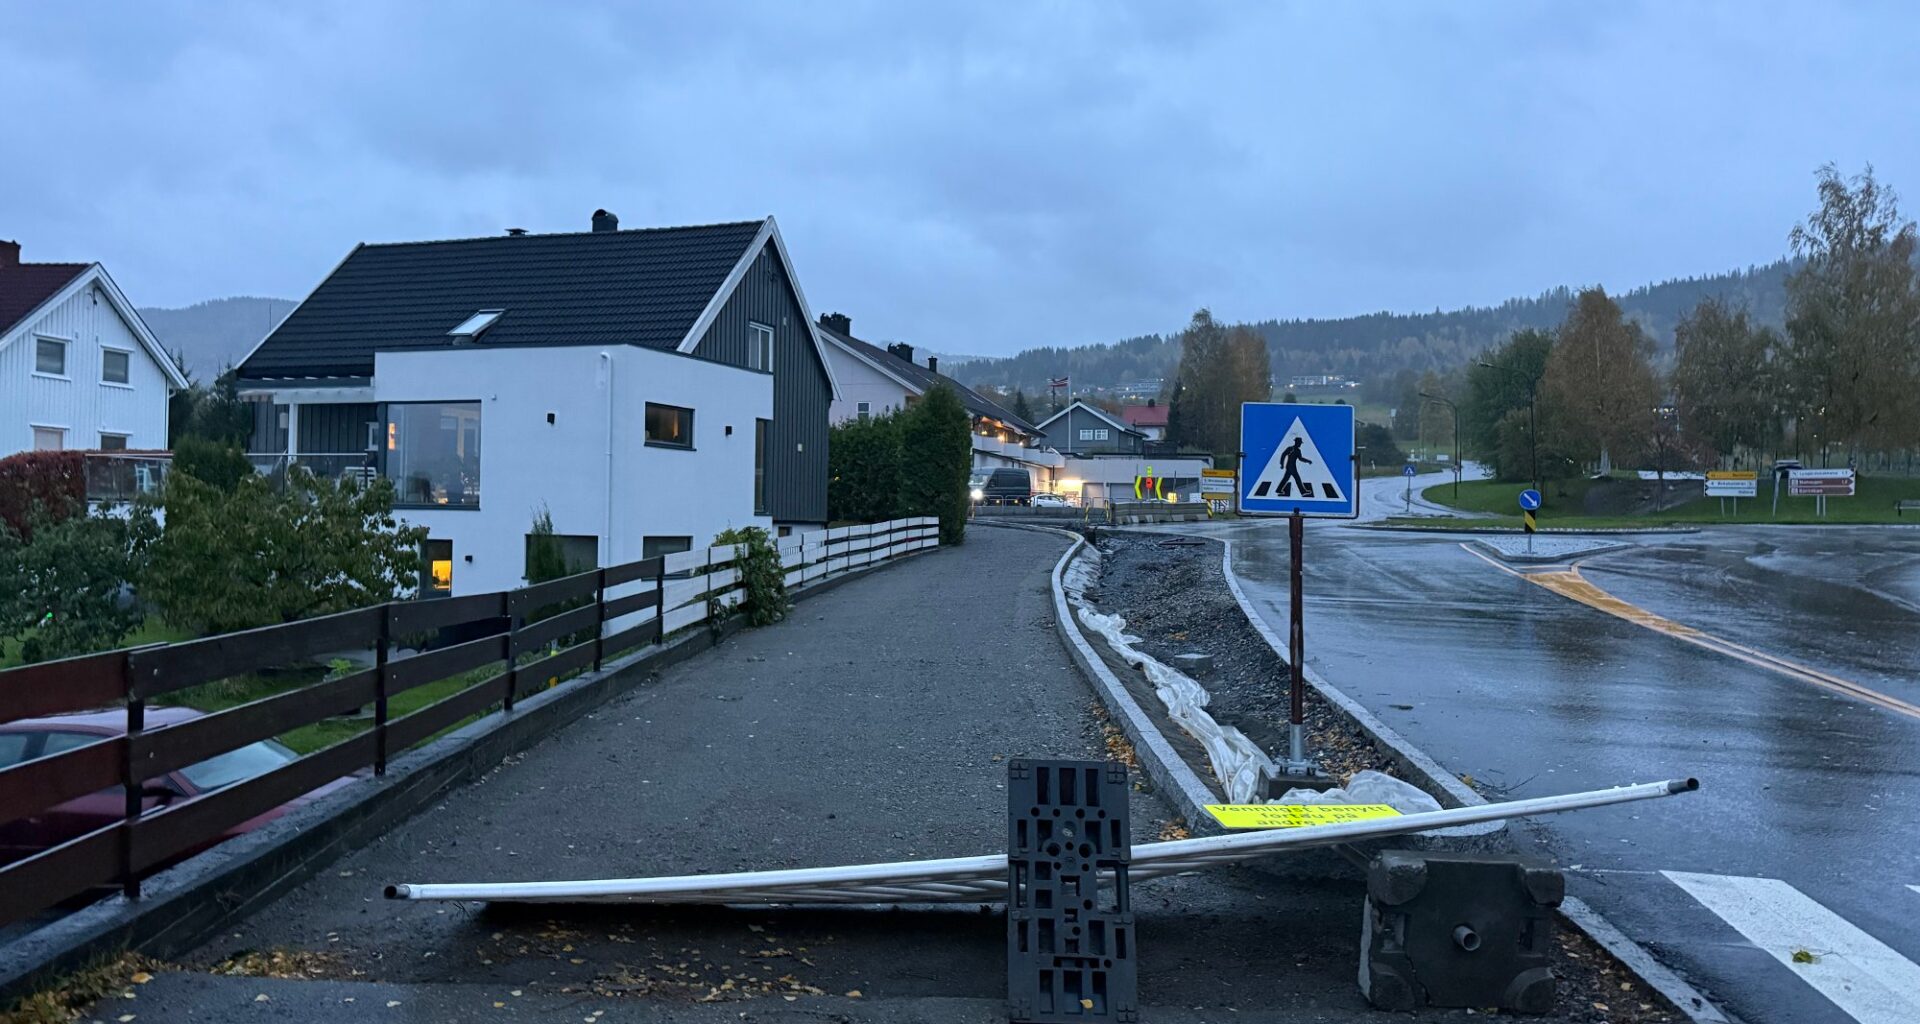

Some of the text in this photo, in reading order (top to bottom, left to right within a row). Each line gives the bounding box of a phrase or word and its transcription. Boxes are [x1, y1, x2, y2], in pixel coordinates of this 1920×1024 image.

[1214, 806, 1388, 814] Vennligst benytt
[1333, 812, 1358, 820] på
